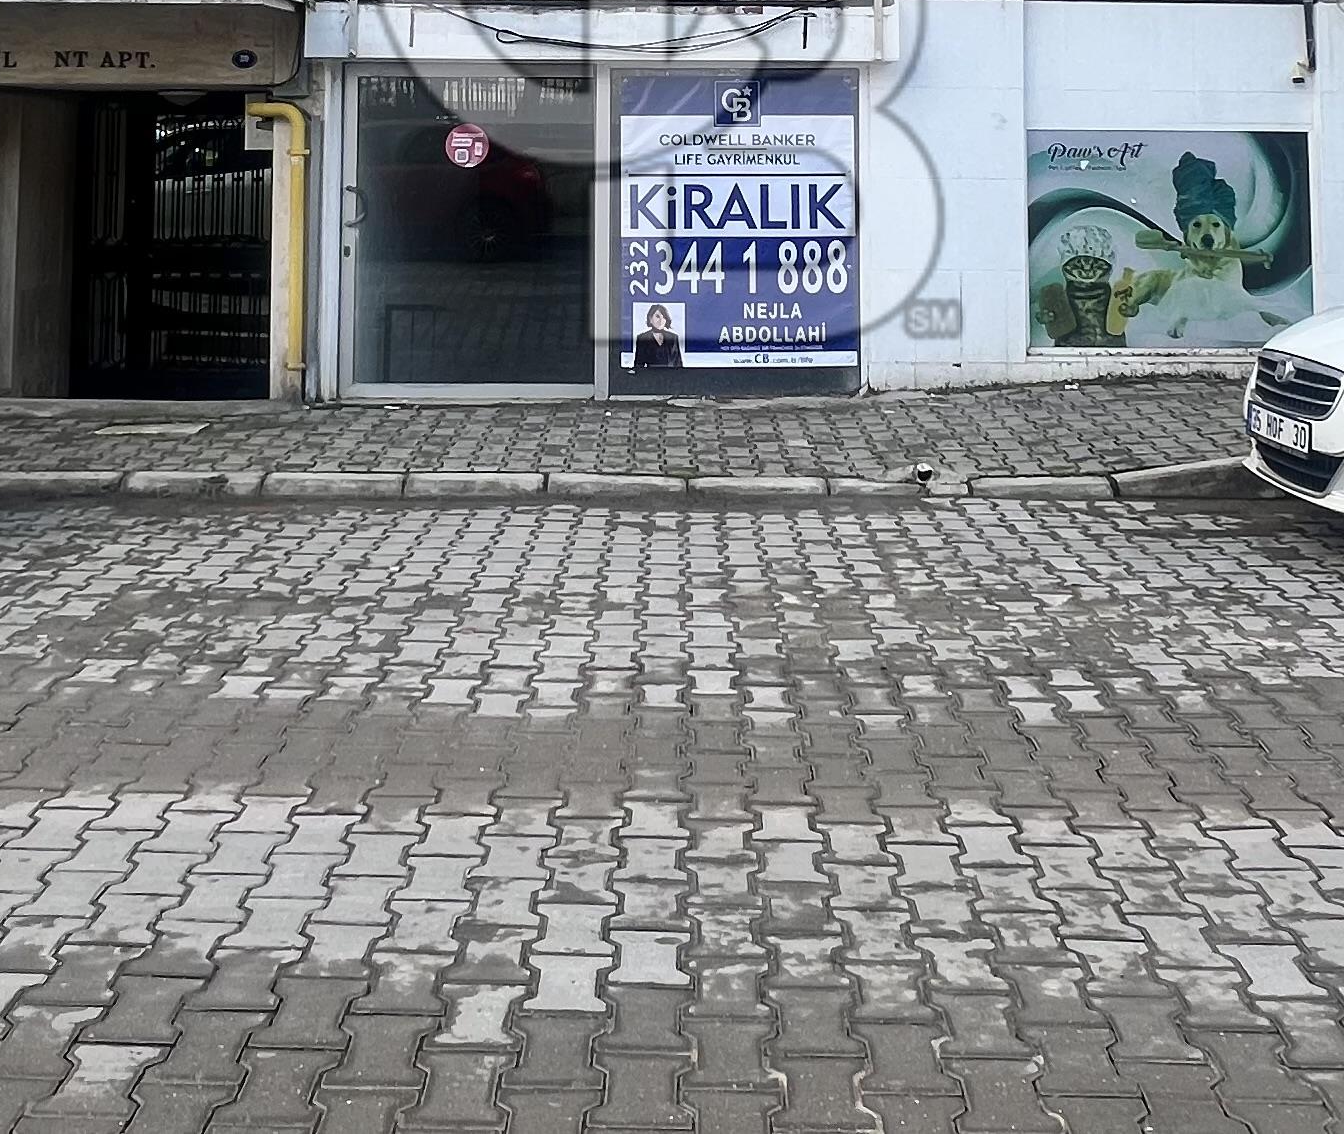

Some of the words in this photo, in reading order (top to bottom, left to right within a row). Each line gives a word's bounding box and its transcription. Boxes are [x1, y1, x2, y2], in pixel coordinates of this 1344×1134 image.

[100, 51, 156, 69] APT.
[659, 134, 747, 146] COLDWELL
[751, 134, 816, 146] BANKER
[674, 153, 702, 165] LIFE
[707, 150, 800, 166] GAYRİMENKUL
[628, 240, 649, 296] 232
[655, 240, 726, 294] 344
[742, 241, 757, 294] 1
[777, 240, 848, 294] 888
[743, 303, 803, 319] NEJLA
[718, 322, 827, 343] ABDOLLAHİ
[1293, 424, 1306, 449] 30
